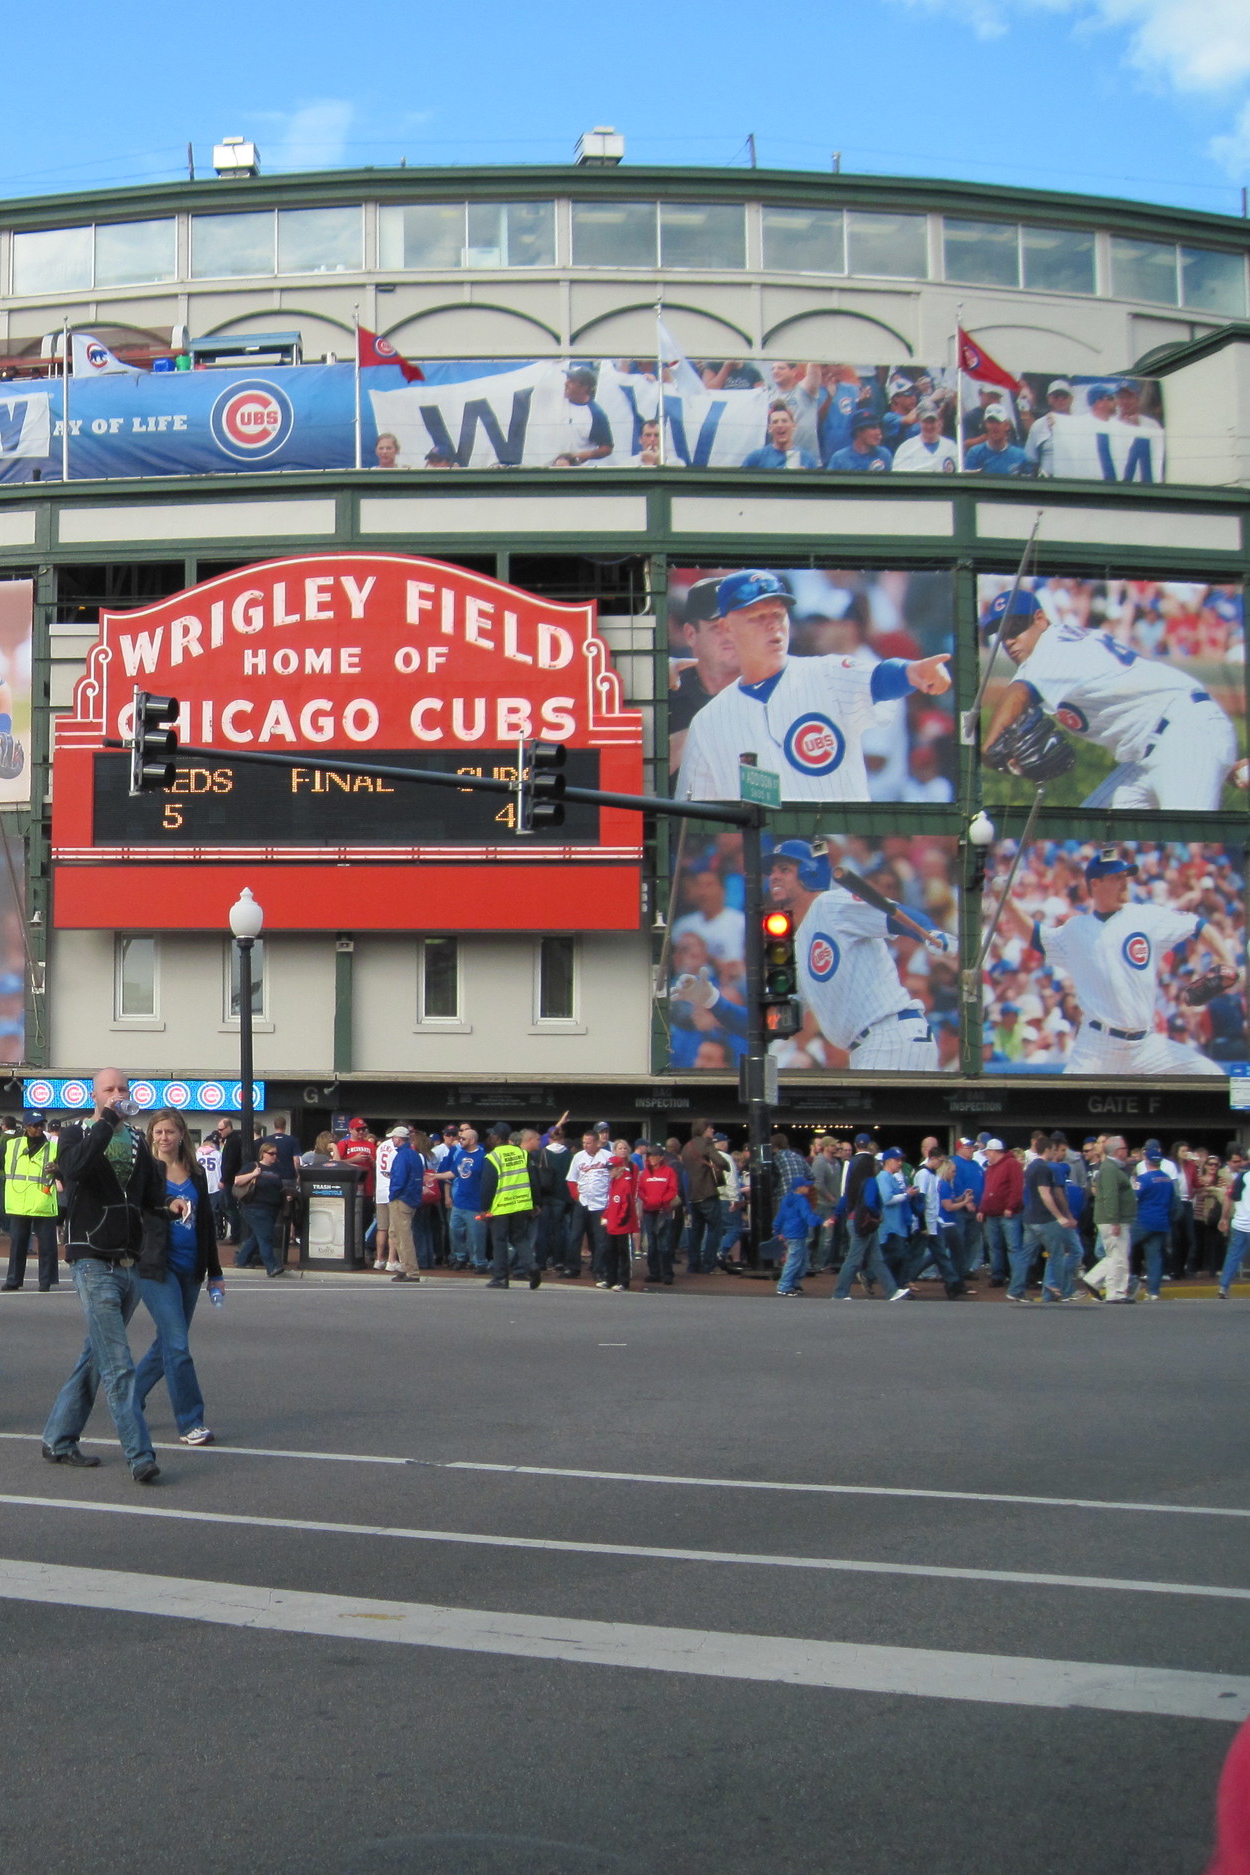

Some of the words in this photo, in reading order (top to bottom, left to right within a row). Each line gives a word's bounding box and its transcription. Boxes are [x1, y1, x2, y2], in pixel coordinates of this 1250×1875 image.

[92, 418, 121, 434] OF
[132, 415, 188, 432] LIFE
[225, 393, 279, 444] CUBS
[119, 576, 377, 677] WRIGLEY
[406, 579, 574, 670] FIELD
[244, 647, 362, 675] HOME
[394, 646, 450, 674] OF
[410, 697, 576, 741] CUBS
[795, 722, 835, 765] CUBS
[163, 769, 233, 793] EDS
[163, 803, 183, 829] 5
[495, 803, 516, 828] 4
[635, 1098, 689, 1108] INSPECTION
[951, 1101, 1002, 1111] INSPECTION
[1087, 1096, 1138, 1113] GATE
[1149, 1096, 1161, 1113] F
[380, 1154, 388, 1170] 5
